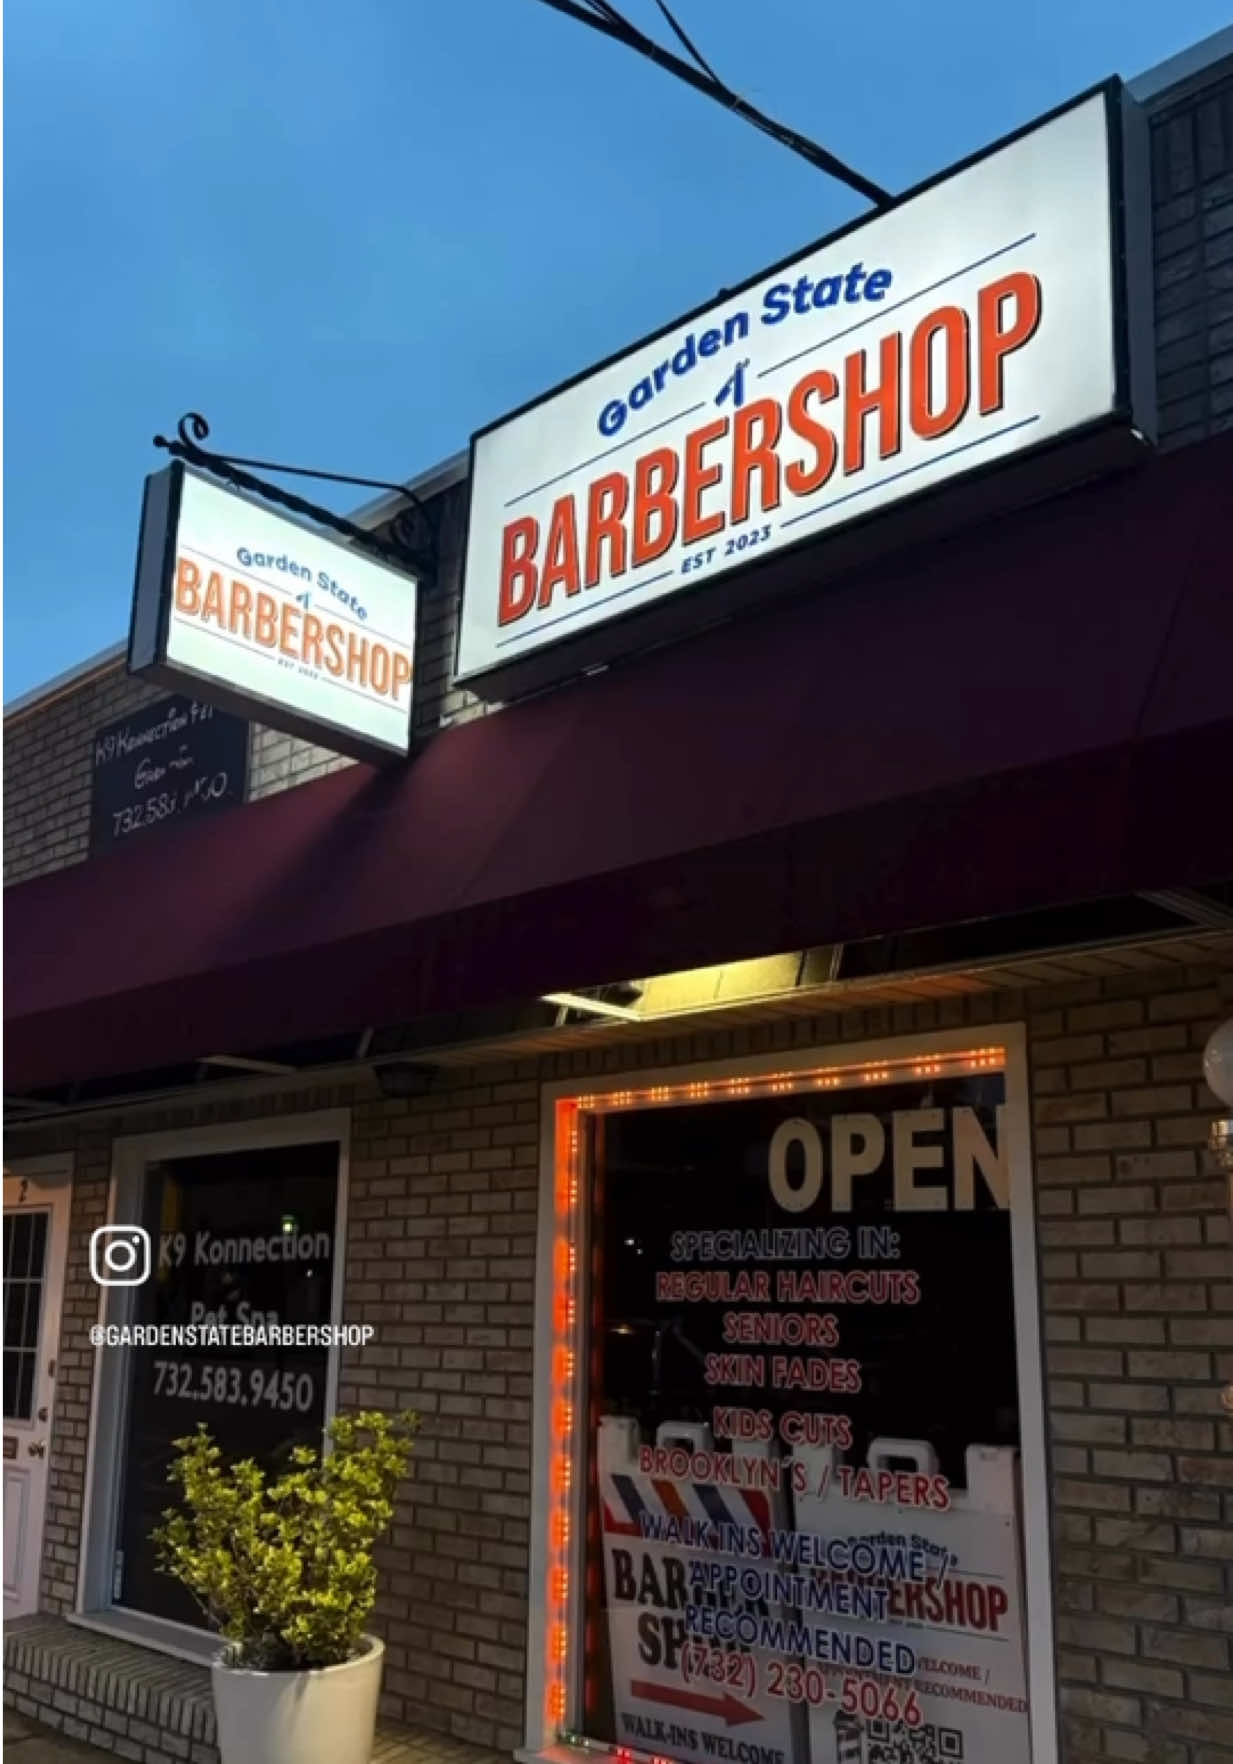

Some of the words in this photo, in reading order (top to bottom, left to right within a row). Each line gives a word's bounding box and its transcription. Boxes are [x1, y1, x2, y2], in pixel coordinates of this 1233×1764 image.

[598, 311, 750, 437] Garden
[761, 262, 893, 326] State
[498, 271, 1042, 627] BARBERSHOP
[681, 549, 714, 574] EST
[724, 525, 772, 556] 2023
[237, 547, 312, 582] Garden
[316, 572, 368, 620] State
[175, 557, 412, 700] BARBERSHOP
[768, 1105, 1012, 1213] OPEN
[158, 1232, 187, 1267] K9
[194, 1230, 330, 1265] Konnection
[671, 1228, 850, 1262] SPECIALIZING
[857, 1225, 901, 1259] IN:
[656, 1270, 769, 1302] REGULAR
[777, 1271, 921, 1305] HAIRCUTS
[723, 1312, 840, 1348] SENIORS
[153, 1360, 314, 1411] 732.583.9450
[704, 1353, 765, 1388] SKIN
[772, 1358, 862, 1394] FADES
[713, 1407, 773, 1441] KIDS
[779, 1411, 853, 1450] CUTS
[839, 1469, 951, 1512] TAPERS
[769, 1531, 925, 1583] WELCOME
[688, 1559, 890, 1622] APPOINTMENT
[684, 1604, 916, 1676] RECOMMENDED
[681, 1641, 757, 1698] (732)
[767, 1660, 924, 1727] 230-5066
[621, 1712, 699, 1750] WALK-INS
